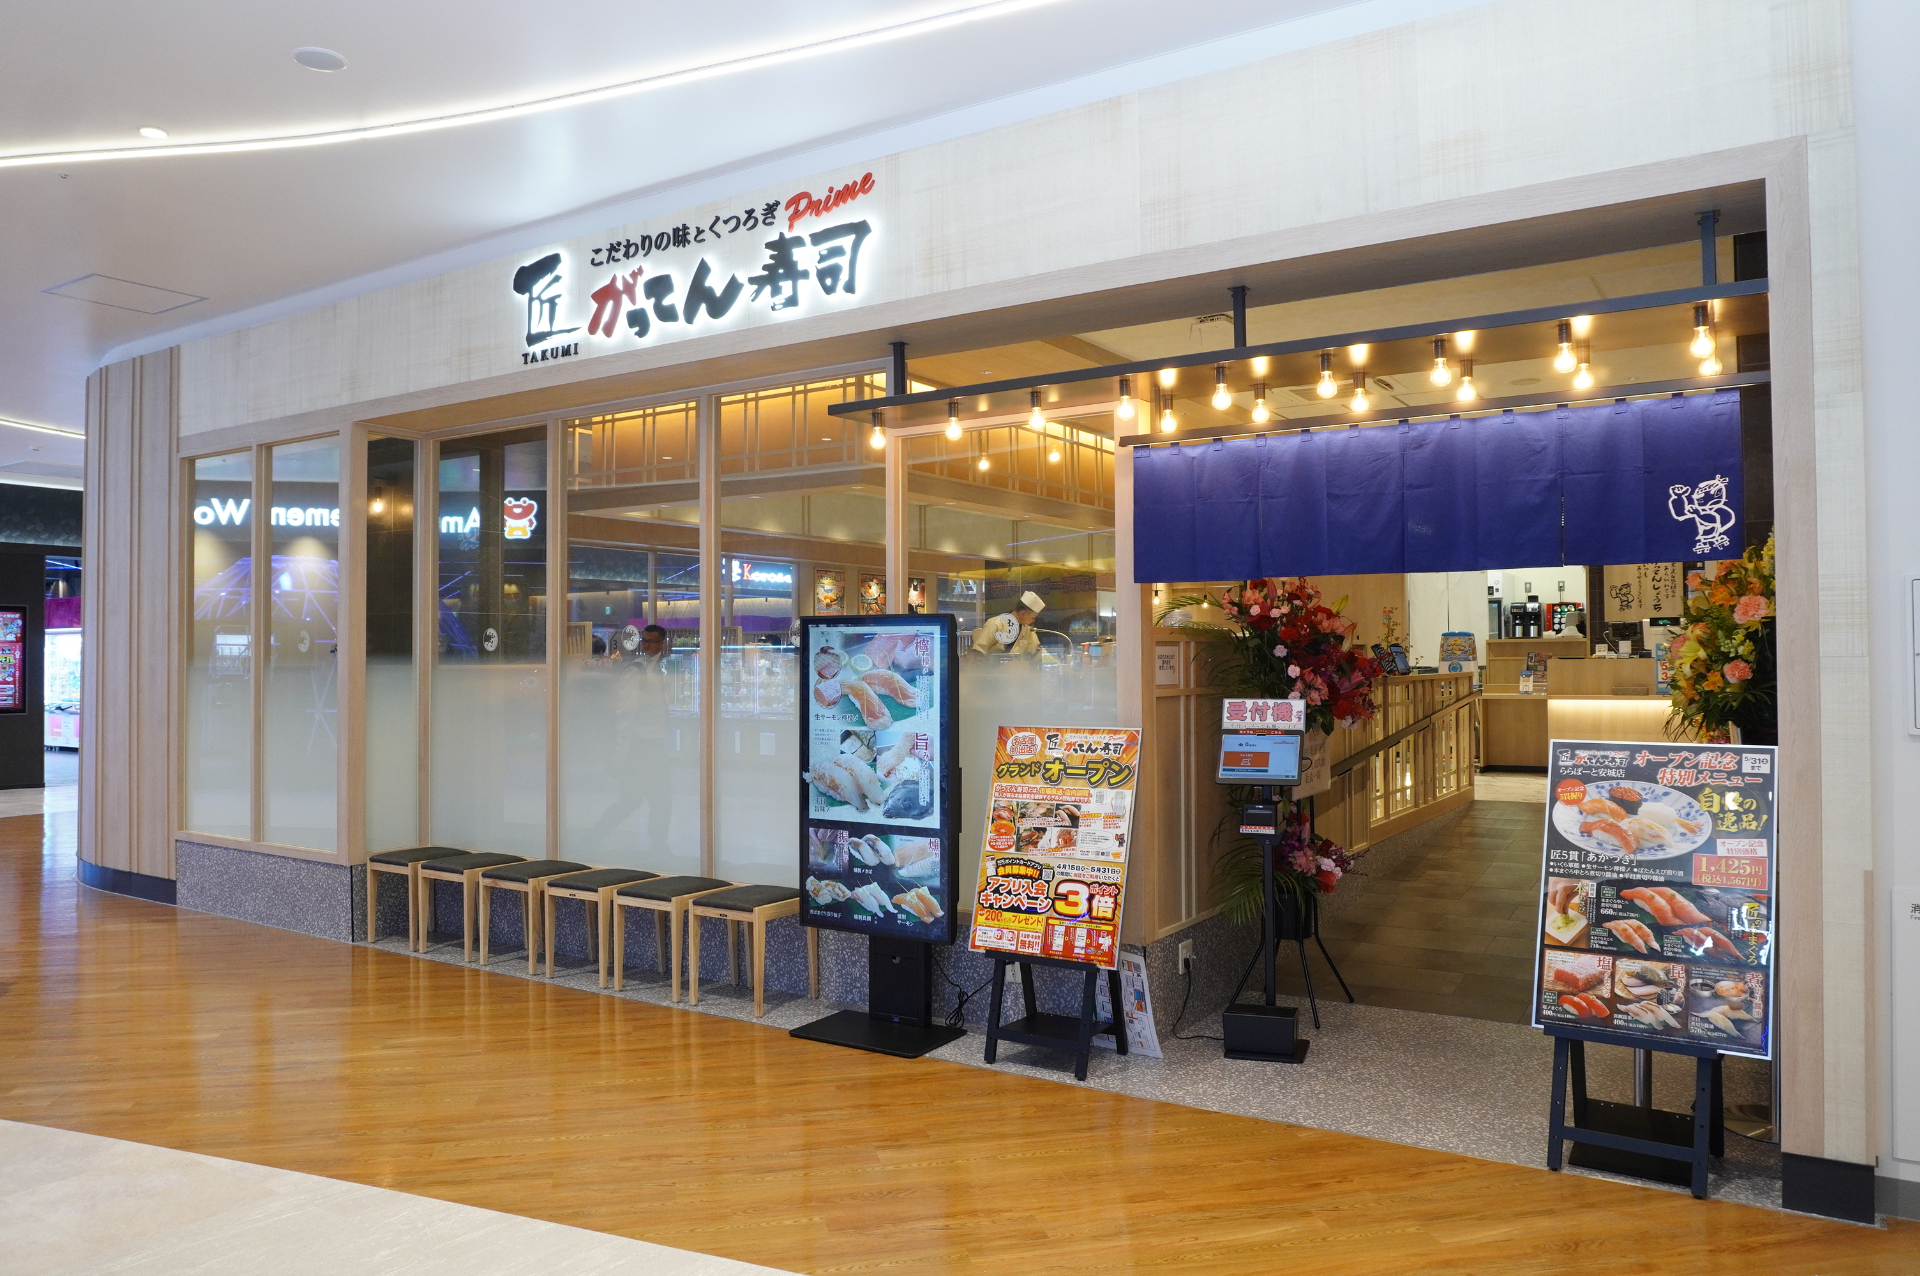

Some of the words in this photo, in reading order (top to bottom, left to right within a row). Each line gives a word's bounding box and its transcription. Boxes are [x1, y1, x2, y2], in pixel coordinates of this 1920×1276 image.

[784, 172, 876, 232] Prime
[590, 200, 781, 267] こだわりの味とくつろぎ
[587, 220, 873, 338] がってん寿司
[512, 252, 583, 348] 匠
[521, 342, 579, 365] TAKUMI
[1652, 563, 1663, 613] ってんしょうち
[1226, 701, 1293, 722] 受付機
[1012, 735, 1036, 745] 名古屋
[1046, 733, 1065, 751] 匠
[1064, 741, 1124, 755] がってん寿司
[1574, 755, 1629, 767] がってん寿司
[1633, 751, 1738, 770] オープン記念
[1560, 767, 1626, 778] ららぽーと安城店
[1658, 768, 1763, 787] 特別メニュー
[1719, 840, 1765, 848] オープン記念
[1726, 847, 1758, 856] 特別価格
[1550, 850, 1638, 866] 匠5貫「あかつき」
[1700, 856, 1763, 876] 1,425円
[1056, 871, 1120, 882] の期間に当店をご利用いただくと
[987, 877, 1049, 897] アプリ入会
[1090, 883, 1119, 895] ポイント
[979, 891, 1052, 913] キャンペーン
[1055, 880, 1090, 918] 3
[1092, 895, 1117, 919] 倍
[1019, 939, 1040, 952] 無料!!
